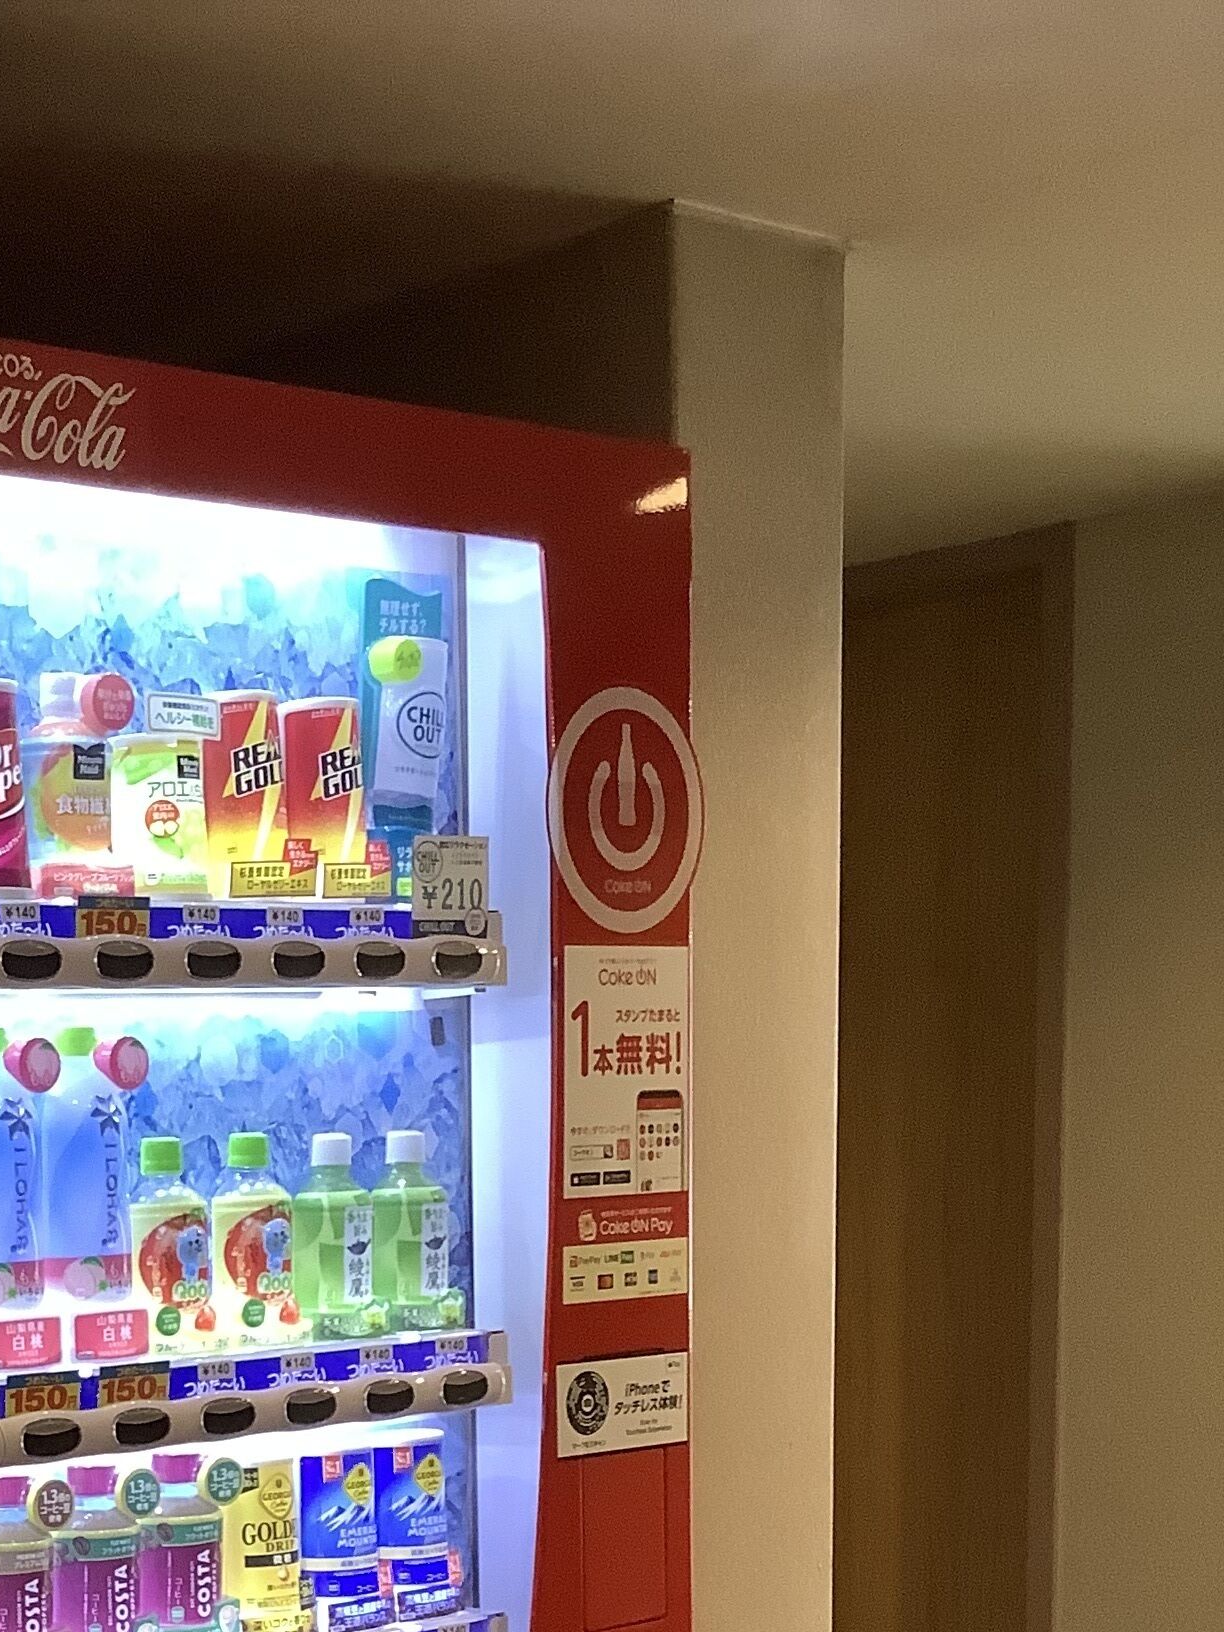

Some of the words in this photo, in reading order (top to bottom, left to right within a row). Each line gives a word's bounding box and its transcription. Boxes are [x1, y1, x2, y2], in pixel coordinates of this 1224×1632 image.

[413, 725, 442, 743] OUT
[421, 878, 483, 910] ¥210
[5, 905, 37, 919] ¥140
[598, 968, 633, 986] Coke
[635, 968, 657, 986] ON
[615, 1008, 681, 1023] スタンプたまると
[571, 1000, 682, 1077] 1本無料!
[599, 1219, 631, 1236] Coke
[650, 1217, 674, 1236] Pay
[12, 1335, 44, 1351] 白桃
[103, 1326, 132, 1342] 白桃
[102, 1375, 168, 1403] 150円
[624, 1380, 671, 1398] iPhoneで
[10, 1385, 77, 1413] 150円
[197, 1550, 212, 1617] COSTA
